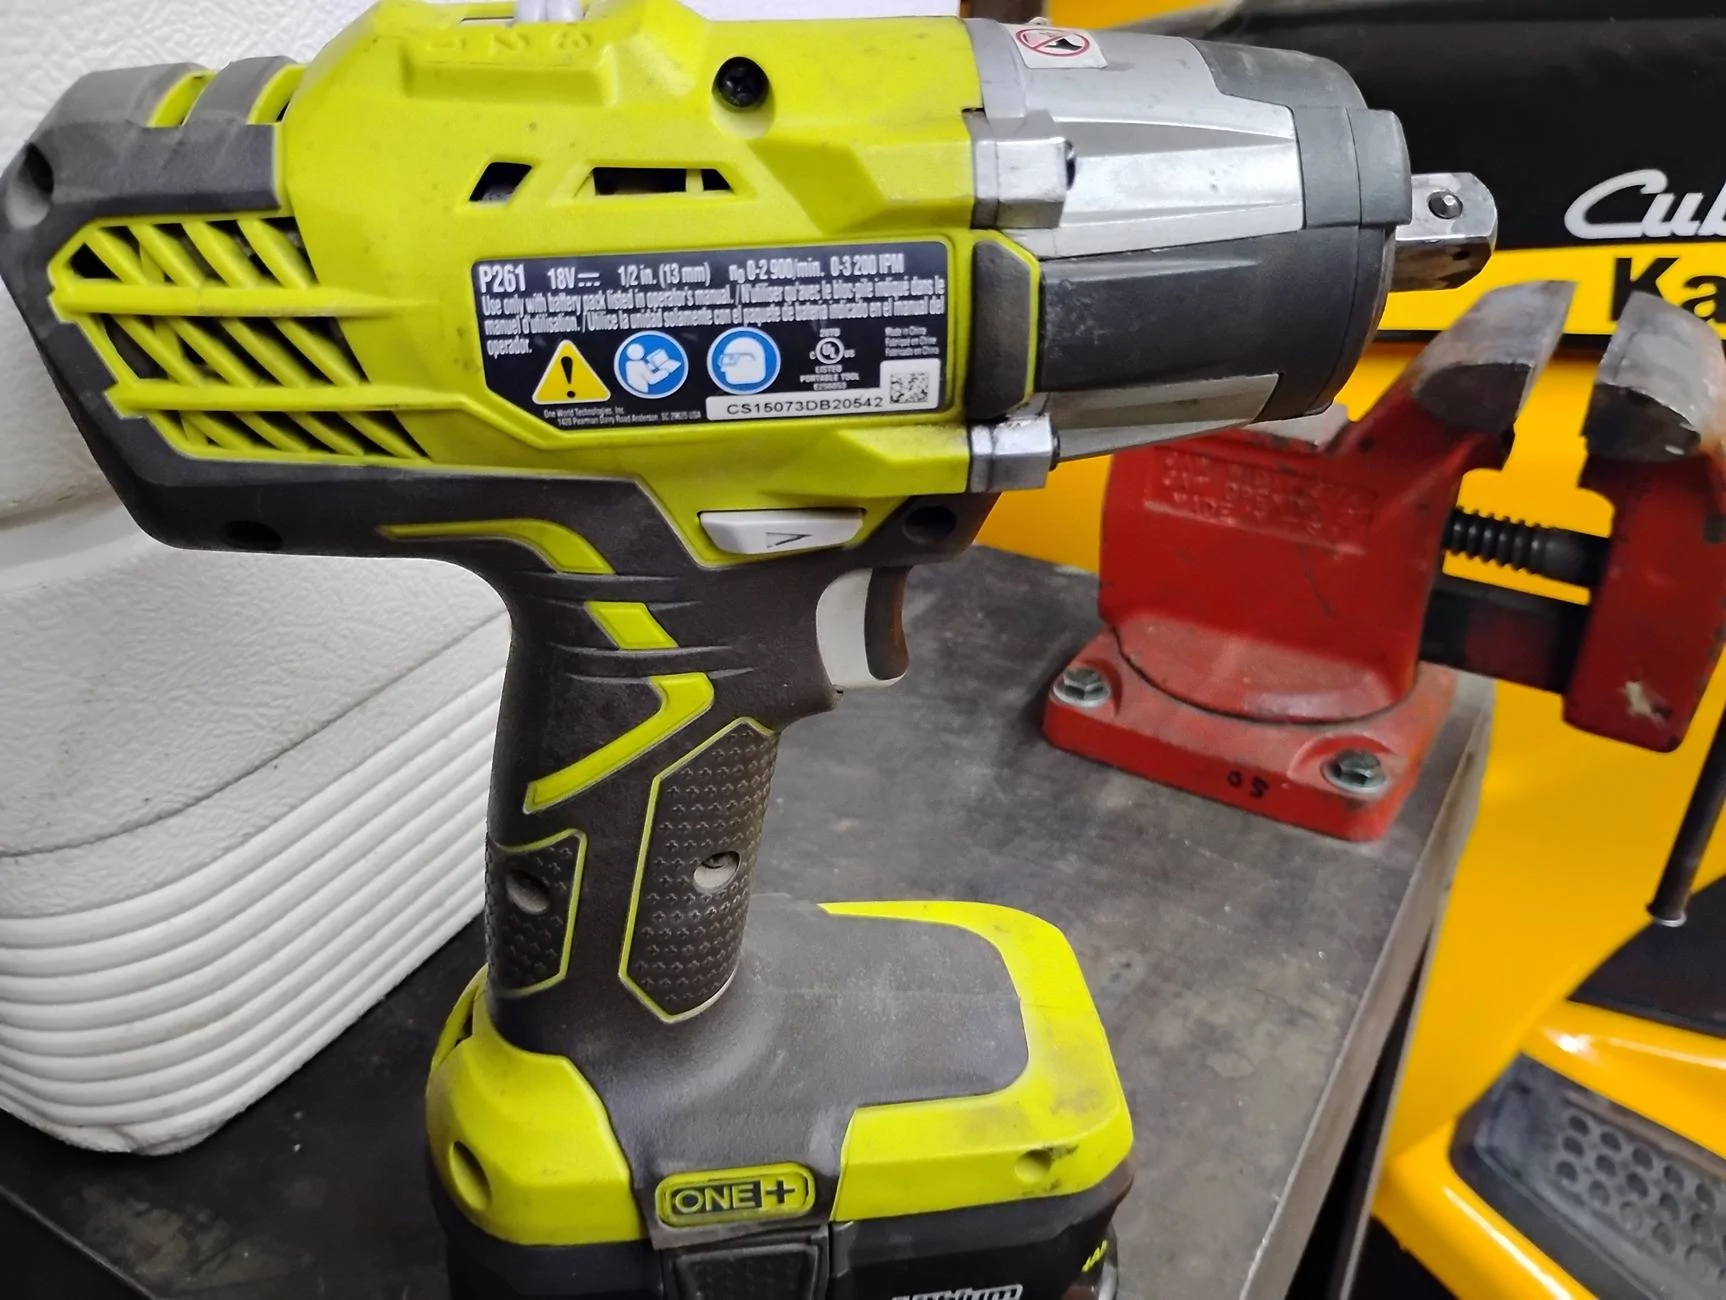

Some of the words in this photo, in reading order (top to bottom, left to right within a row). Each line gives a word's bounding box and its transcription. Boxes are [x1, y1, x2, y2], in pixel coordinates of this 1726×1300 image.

[479, 263, 526, 293] P261
[547, 267, 576, 290] 18V
[879, 253, 905, 274] IPM
[482, 294, 502, 315] Use
[503, 293, 525, 319] only
[525, 292, 548, 312] with
[548, 291, 581, 316] battery
[583, 290, 606, 317] pack
[606, 289, 634, 310] listed
[635, 289, 646, 308] in
[646, 286, 695, 310] operator's
[695, 284, 734, 306] manual.
[911, 276, 934, 296] dans
[934, 275, 945, 295] le
[485, 314, 521, 336] manuel
[619, 309, 629, 330] la
[630, 308, 662, 329] unidad
[663, 307, 712, 328] solamente
[713, 308, 731, 325] con
[732, 305, 742, 324] el
[743, 303, 781, 328] paquete
[893, 296, 929, 316] manual
[929, 295, 945, 315] del
[486, 335, 533, 359] operador.
[727, 396, 883, 415] CS15073DB20542
